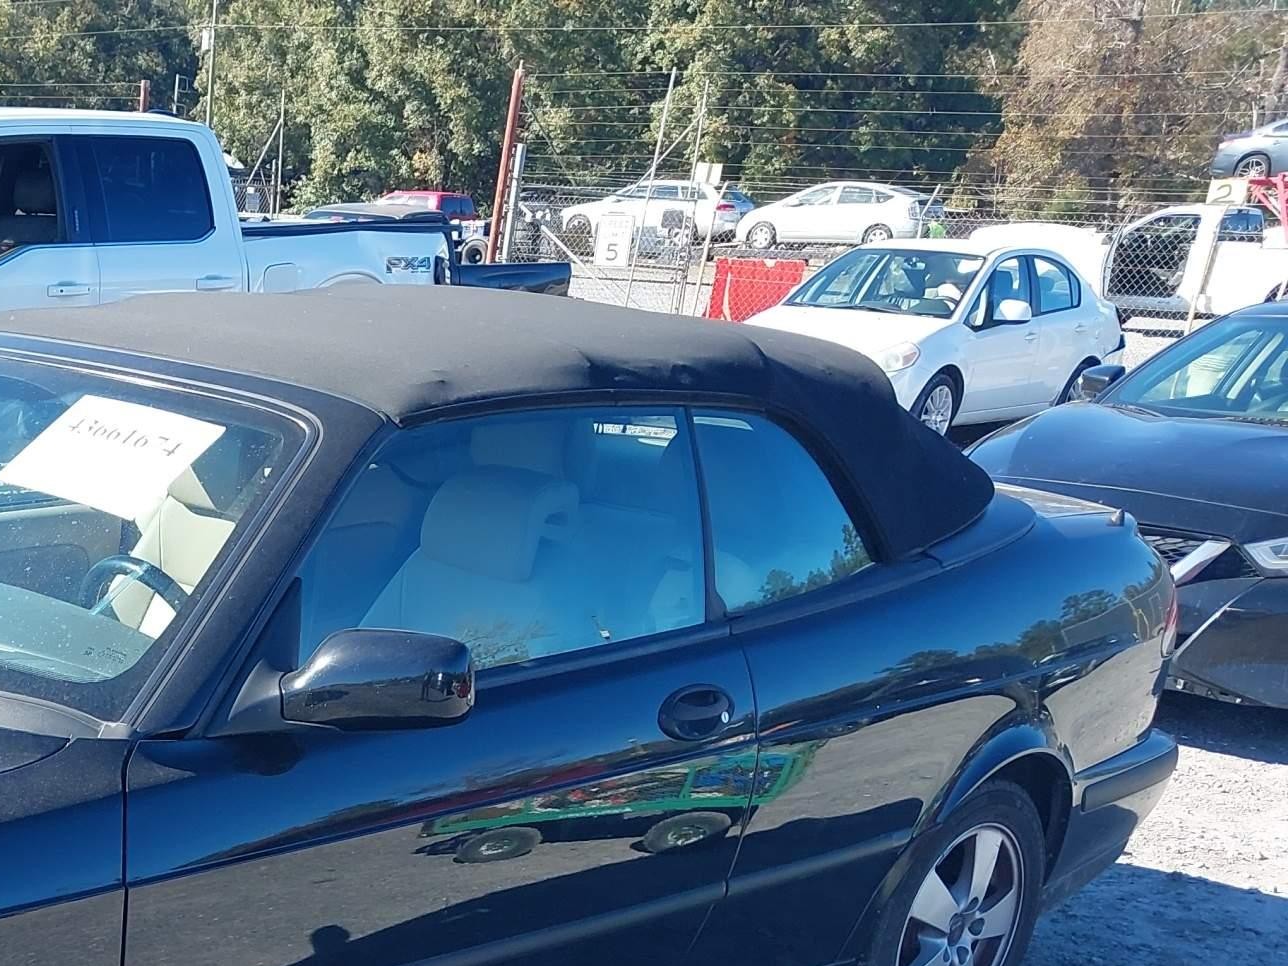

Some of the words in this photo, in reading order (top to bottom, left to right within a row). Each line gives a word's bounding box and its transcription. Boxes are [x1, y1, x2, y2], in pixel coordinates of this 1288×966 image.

[1212, 184, 1235, 203] 2
[606, 243, 618, 261] 5
[386, 256, 431, 273] FX4
